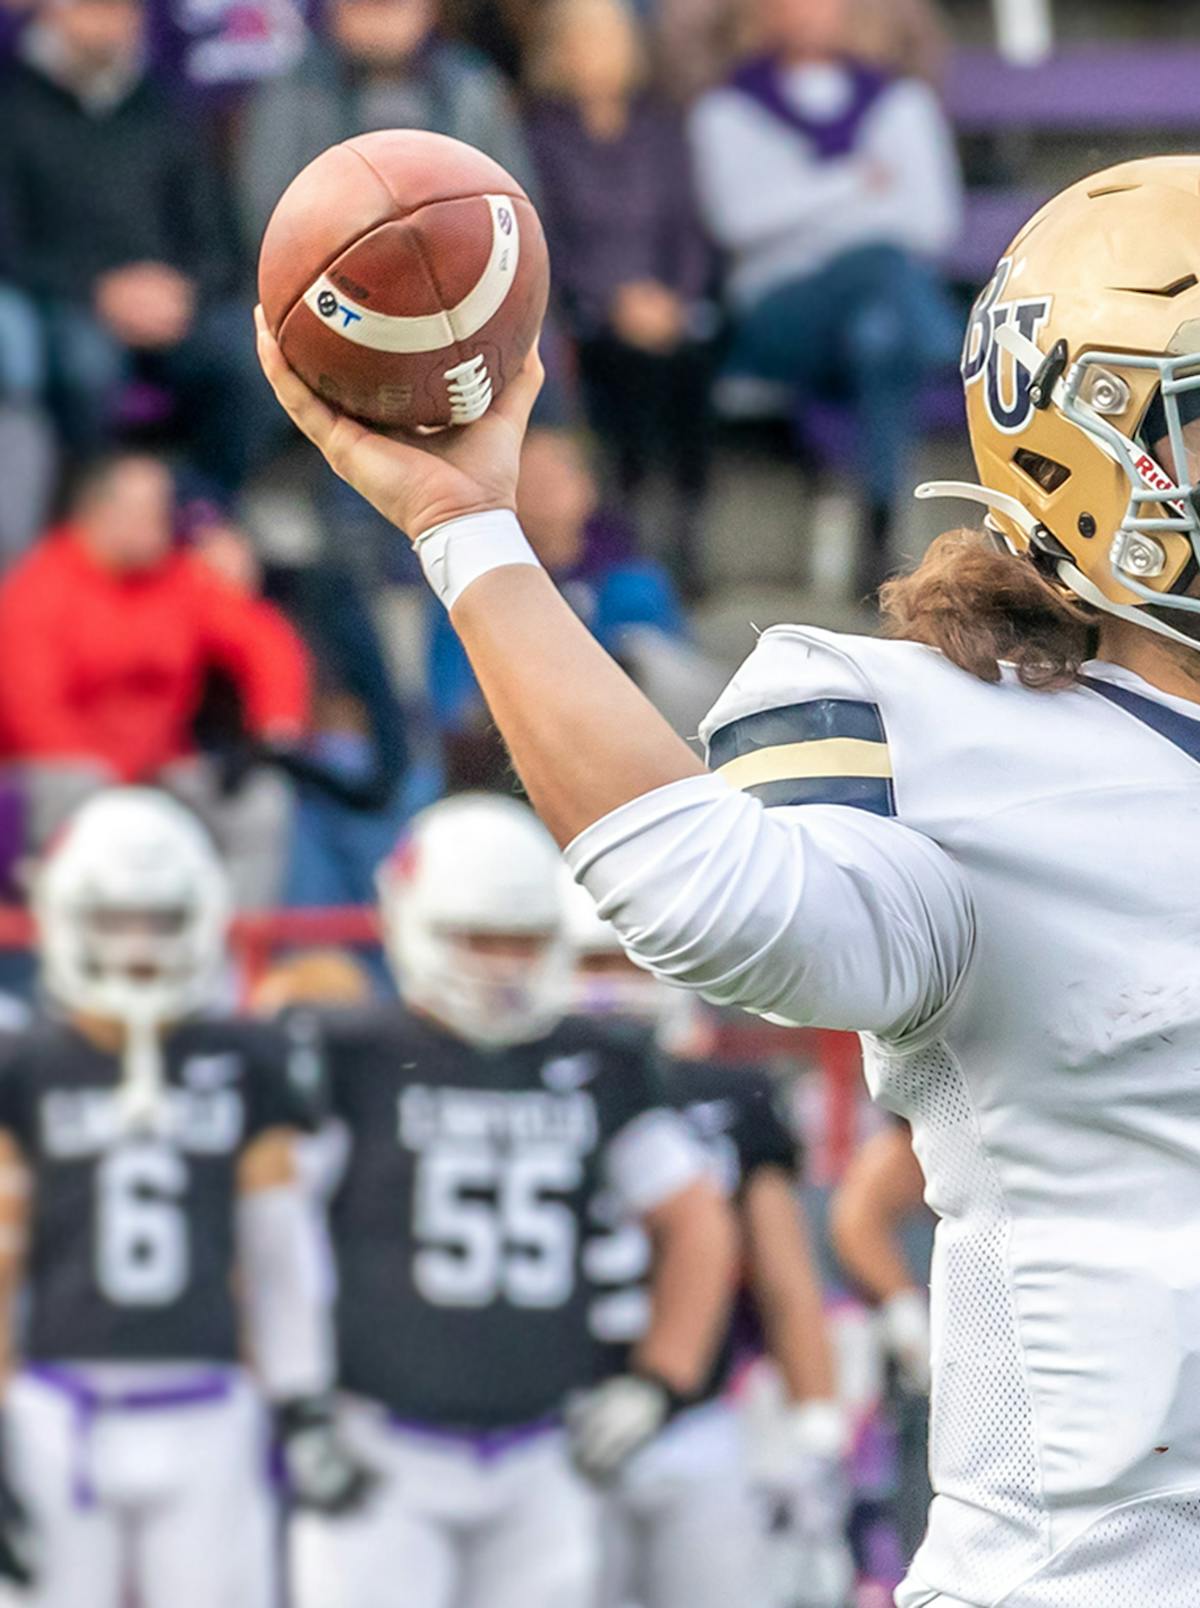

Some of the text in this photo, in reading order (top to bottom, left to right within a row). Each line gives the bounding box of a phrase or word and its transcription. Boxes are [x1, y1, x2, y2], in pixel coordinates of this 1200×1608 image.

[962, 257, 1053, 434] BU
[97, 1146, 188, 1304] 6
[414, 1150, 580, 1307] 55
